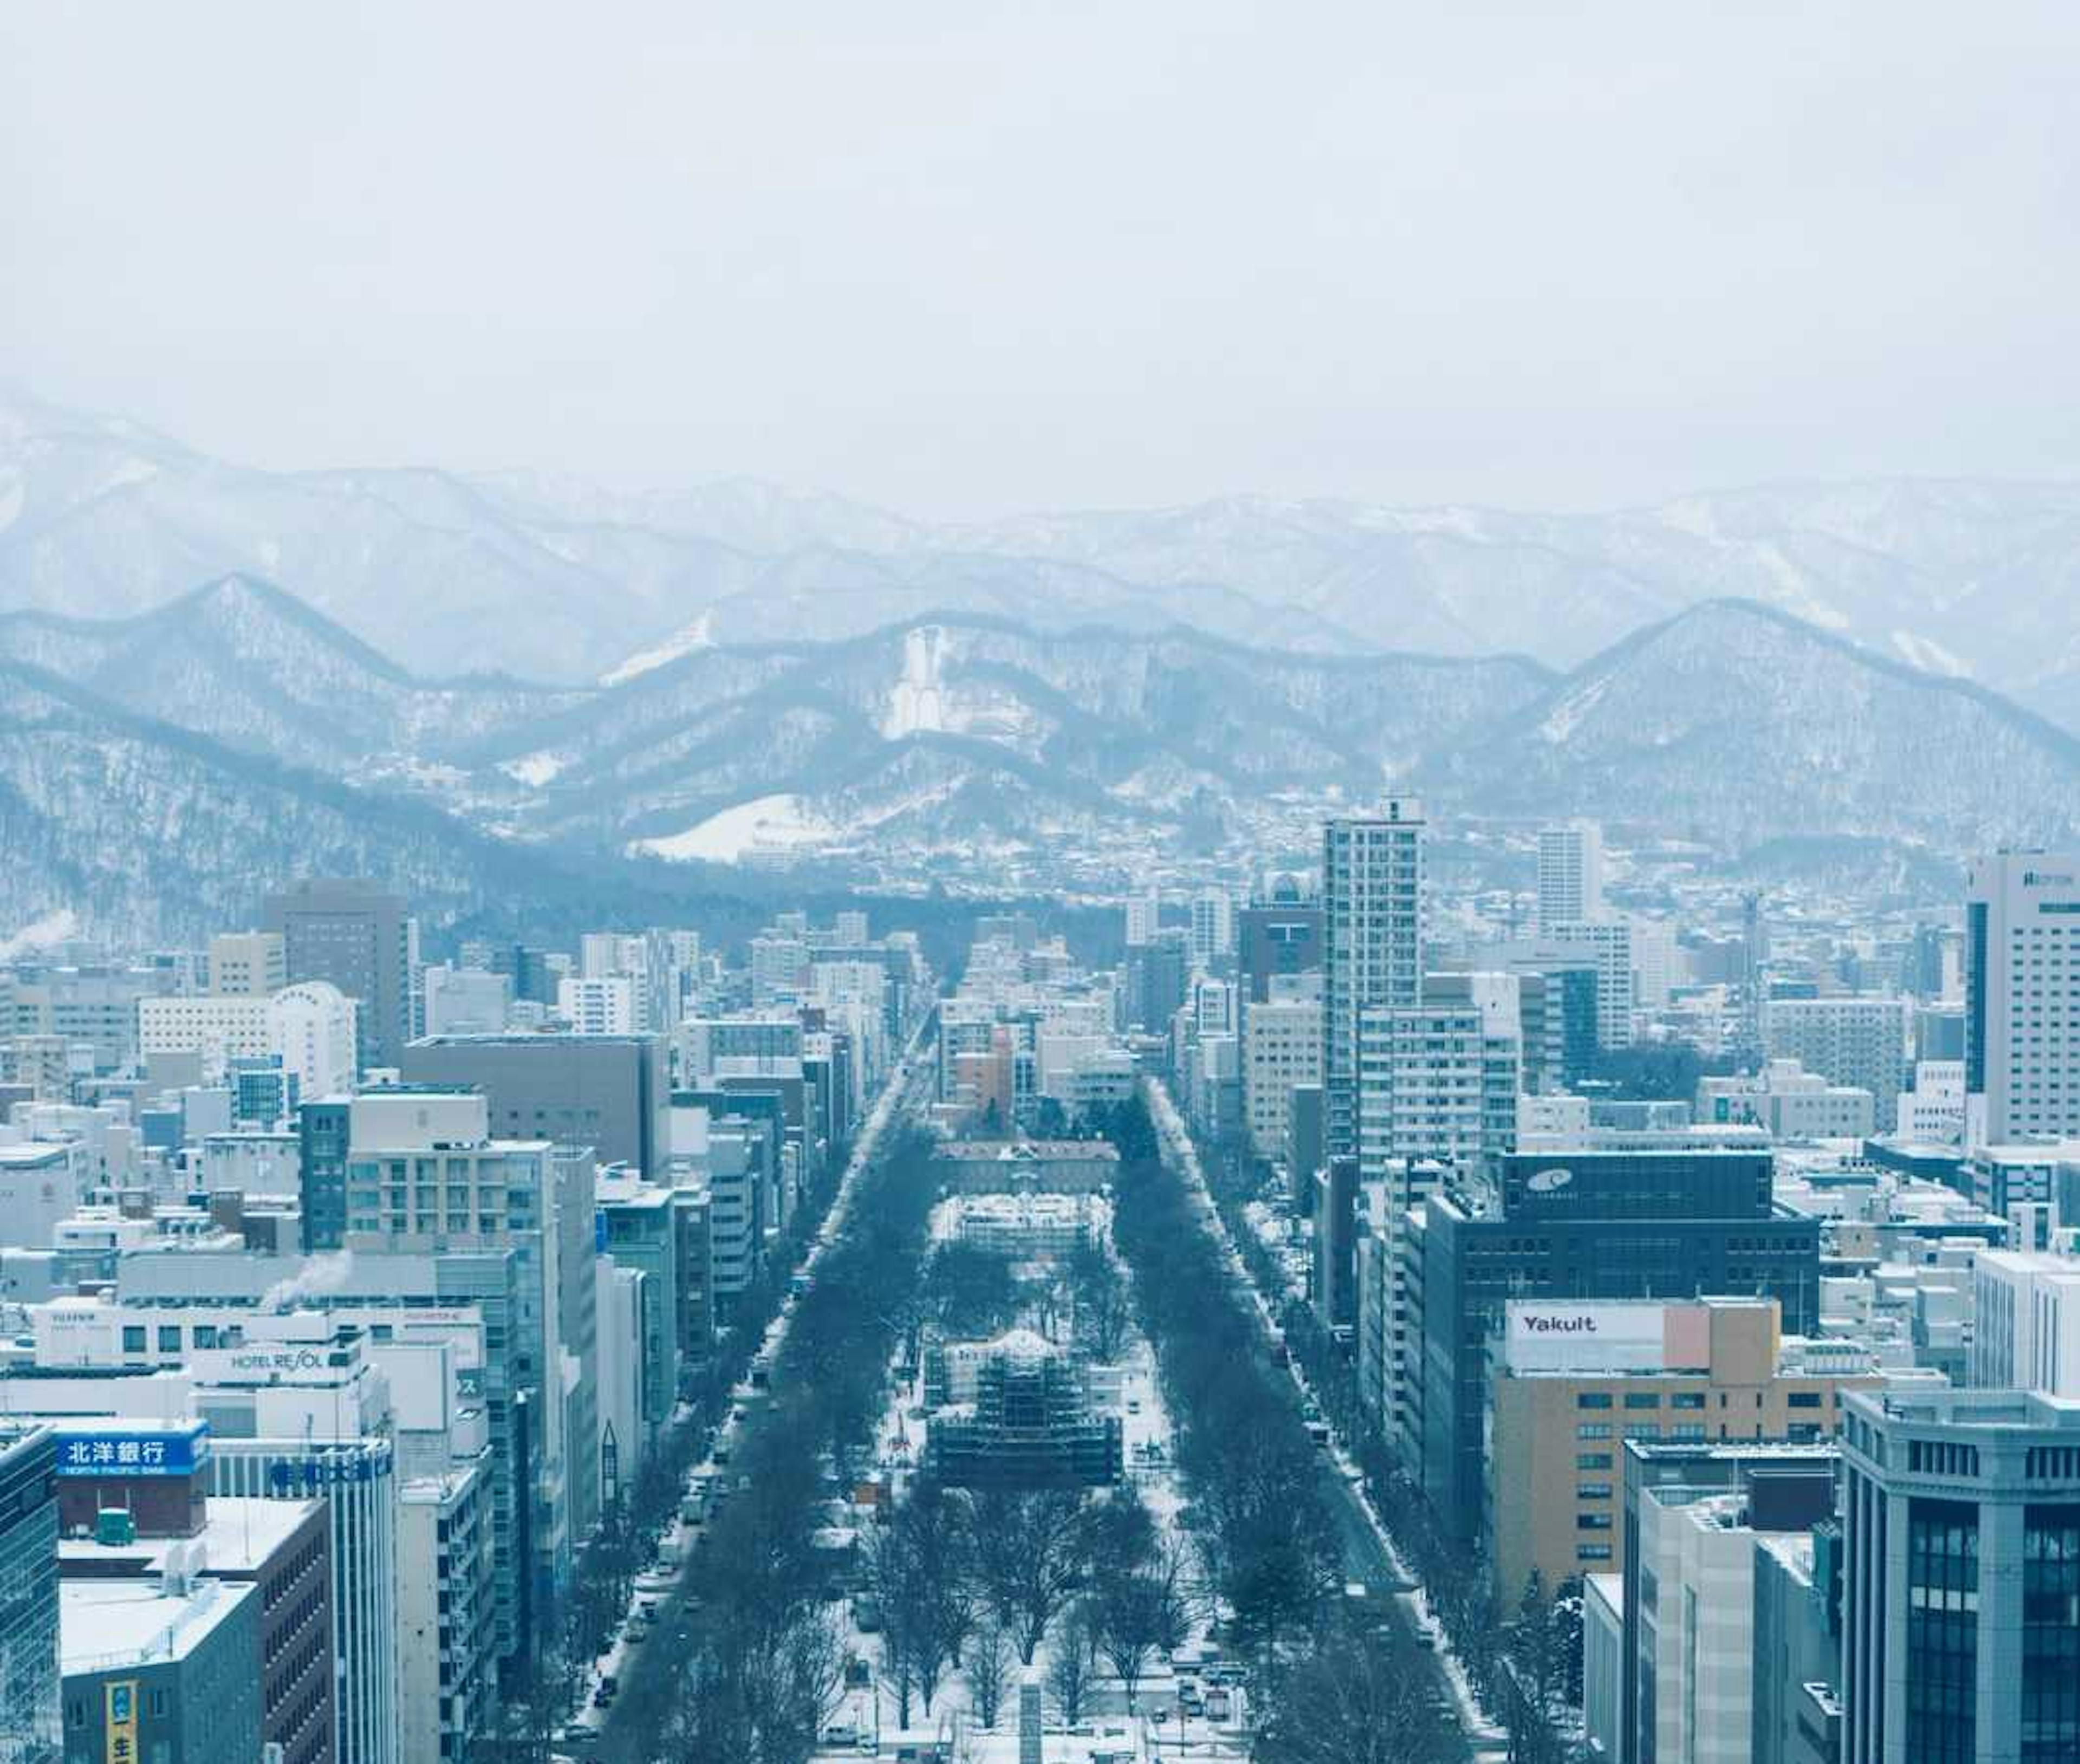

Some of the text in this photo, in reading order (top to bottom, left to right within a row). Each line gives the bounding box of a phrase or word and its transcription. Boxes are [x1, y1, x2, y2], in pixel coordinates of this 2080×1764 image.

[1524, 1317, 1596, 1332] Yakult
[232, 1355, 270, 1368] HOTEL
[67, 1441, 164, 1464] 北洋銀行
